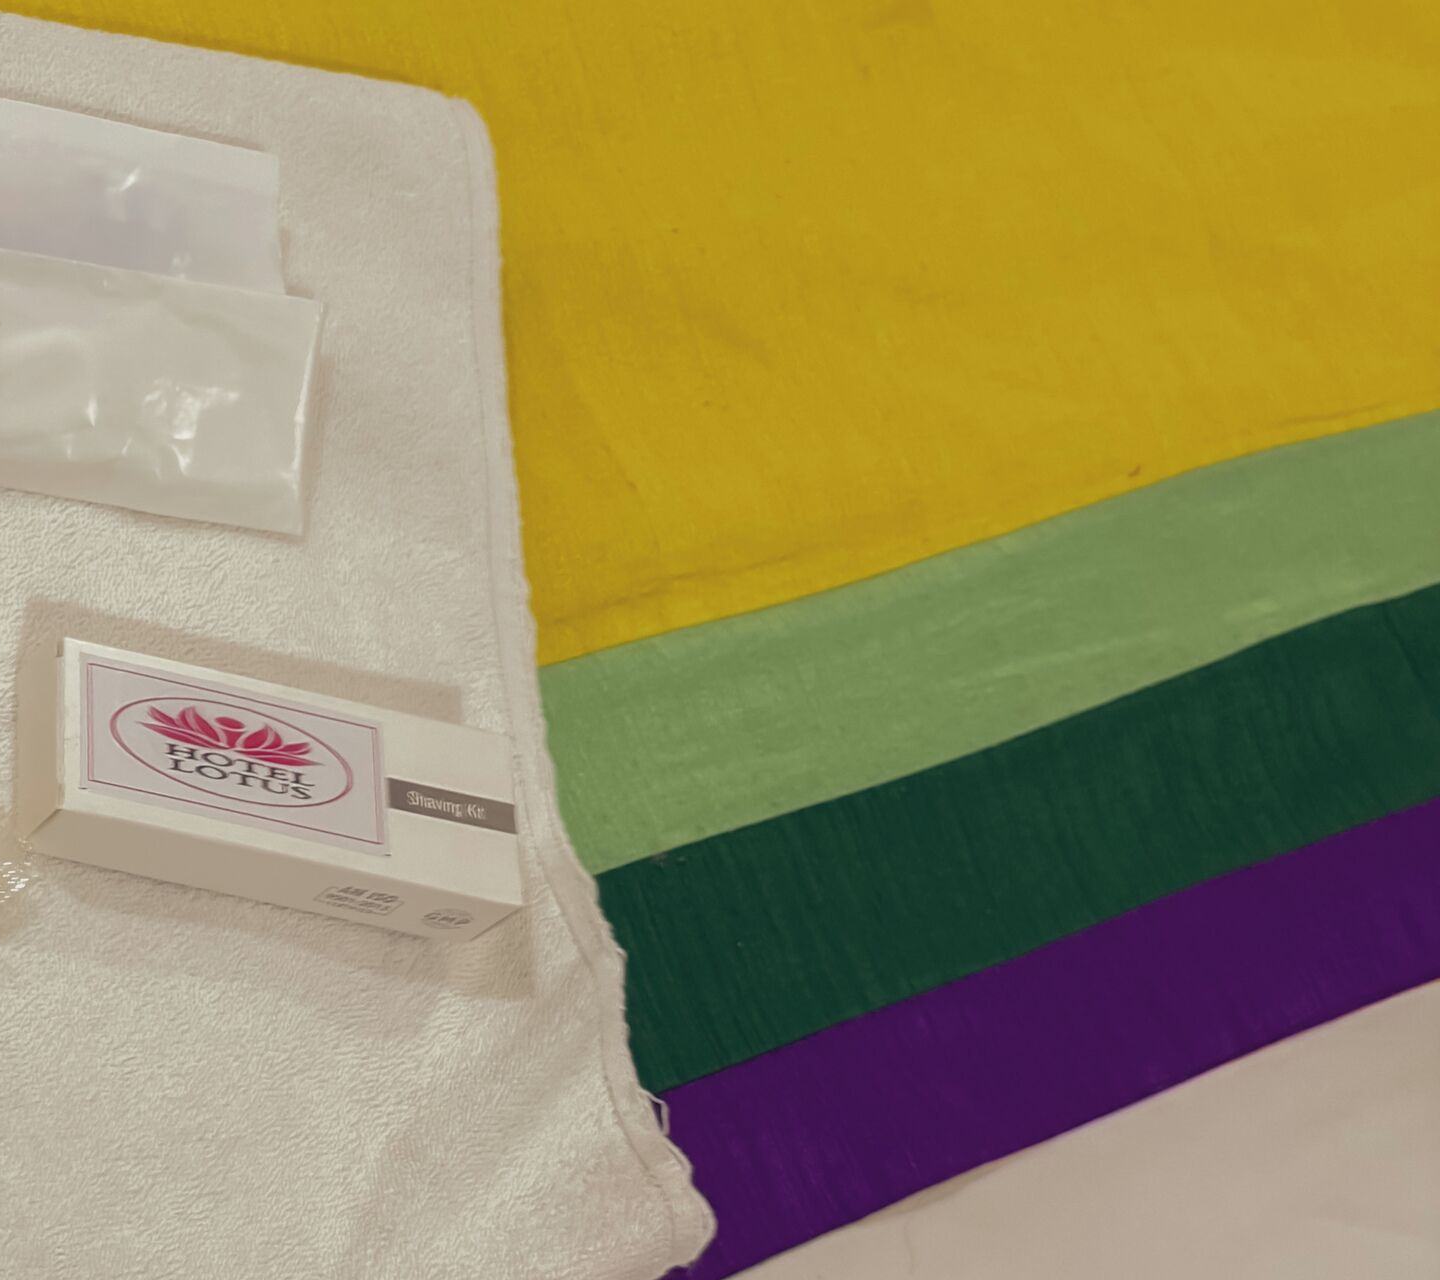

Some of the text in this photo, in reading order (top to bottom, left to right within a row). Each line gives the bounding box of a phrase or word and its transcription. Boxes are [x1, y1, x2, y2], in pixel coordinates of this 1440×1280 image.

[165, 742, 315, 787] HOTEL
[167, 758, 313, 800] LOTUS
[406, 791, 463, 818] Shaving
